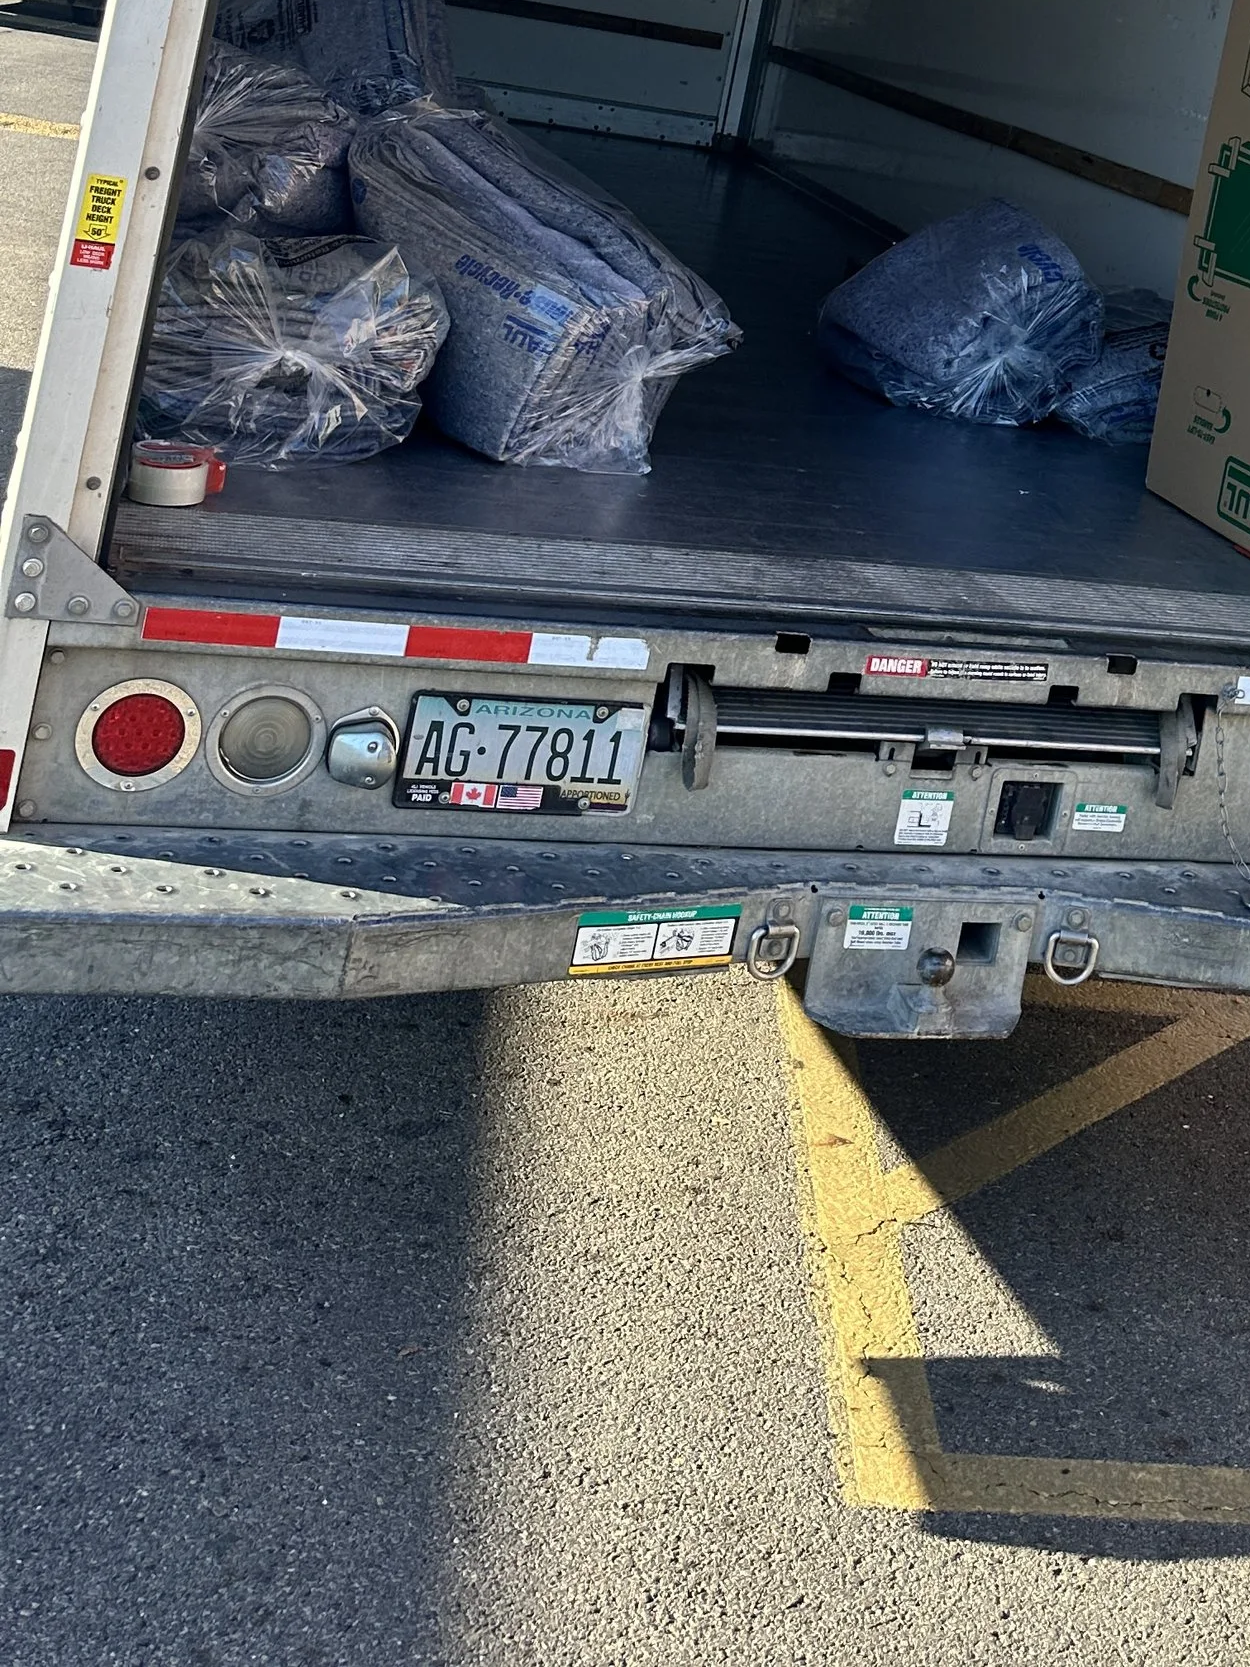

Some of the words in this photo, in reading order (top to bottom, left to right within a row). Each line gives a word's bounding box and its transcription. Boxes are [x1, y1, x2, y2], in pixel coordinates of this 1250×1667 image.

[89, 185, 122, 197] FREIGHT
[91, 195, 116, 205] TRUCK
[91, 204, 112, 214] DECK
[86, 213, 114, 224] HEIGHT
[870, 657, 922, 674] DANGER
[475, 703, 592, 720] ARIZONA
[411, 793, 432, 802] PAID
[911, 791, 948, 800] ATTENTION
[1084, 804, 1118, 813] ATTENTION
[861, 911, 900, 920] ATTENTION
